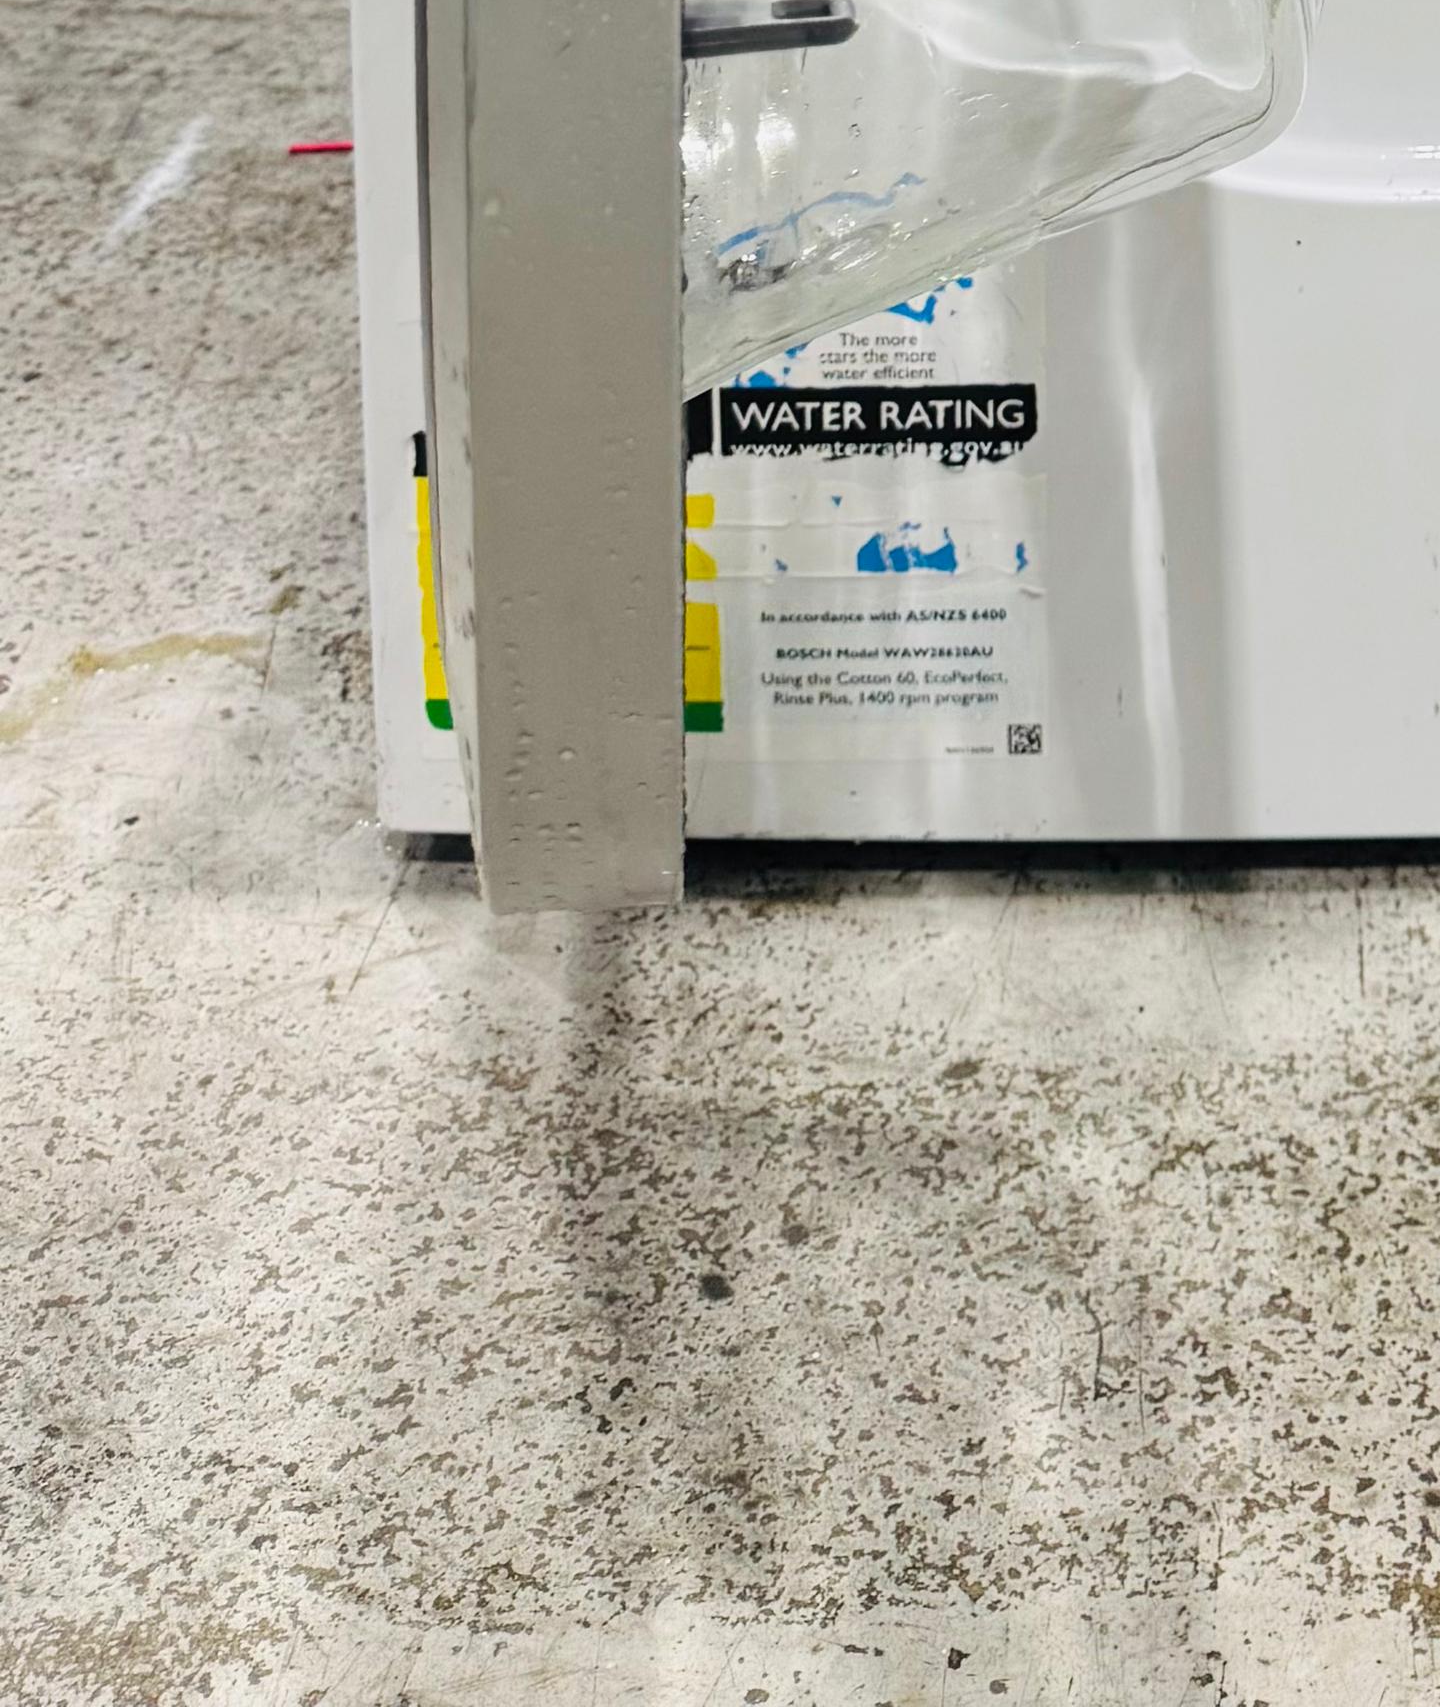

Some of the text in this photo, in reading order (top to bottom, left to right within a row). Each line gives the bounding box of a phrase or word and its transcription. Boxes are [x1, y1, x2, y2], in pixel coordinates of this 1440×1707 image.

[839, 332, 918, 347] The more
[819, 350, 936, 363] stars the more
[822, 366, 935, 380] water efficient
[731, 399, 1026, 431] WATER RATING
[760, 609, 1007, 623] In accordance with AS/NZS 6400
[776, 647, 831, 660] BOSCH
[837, 647, 879, 659] Model
[761, 672, 803, 690] Using
[807, 672, 831, 685] the
[837, 672, 892, 685] Cotton
[924, 671, 1009, 685] EcoPerfect,
[773, 691, 999, 707] Rinse Plus, 1400 rpm program
